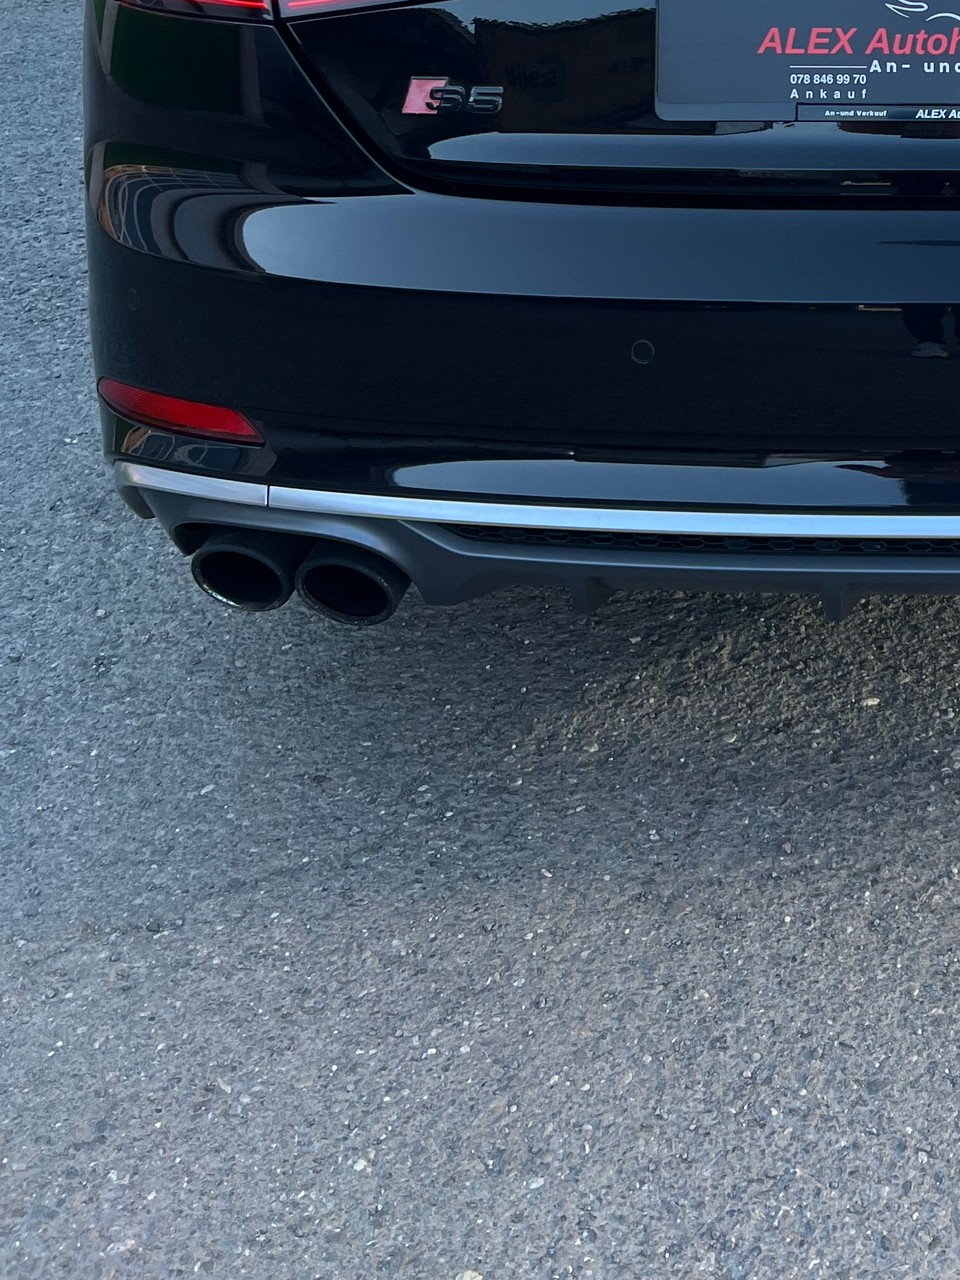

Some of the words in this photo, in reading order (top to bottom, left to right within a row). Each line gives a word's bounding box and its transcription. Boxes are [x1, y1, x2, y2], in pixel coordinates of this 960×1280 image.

[757, 27, 858, 55] ALEX
[789, 74, 811, 85] 078
[813, 74, 833, 85] 846
[836, 74, 850, 85] 99
[853, 74, 867, 85] 70
[425, 85, 504, 114] S5
[790, 89, 867, 99] Ankauf
[915, 109, 947, 119] ALEX
